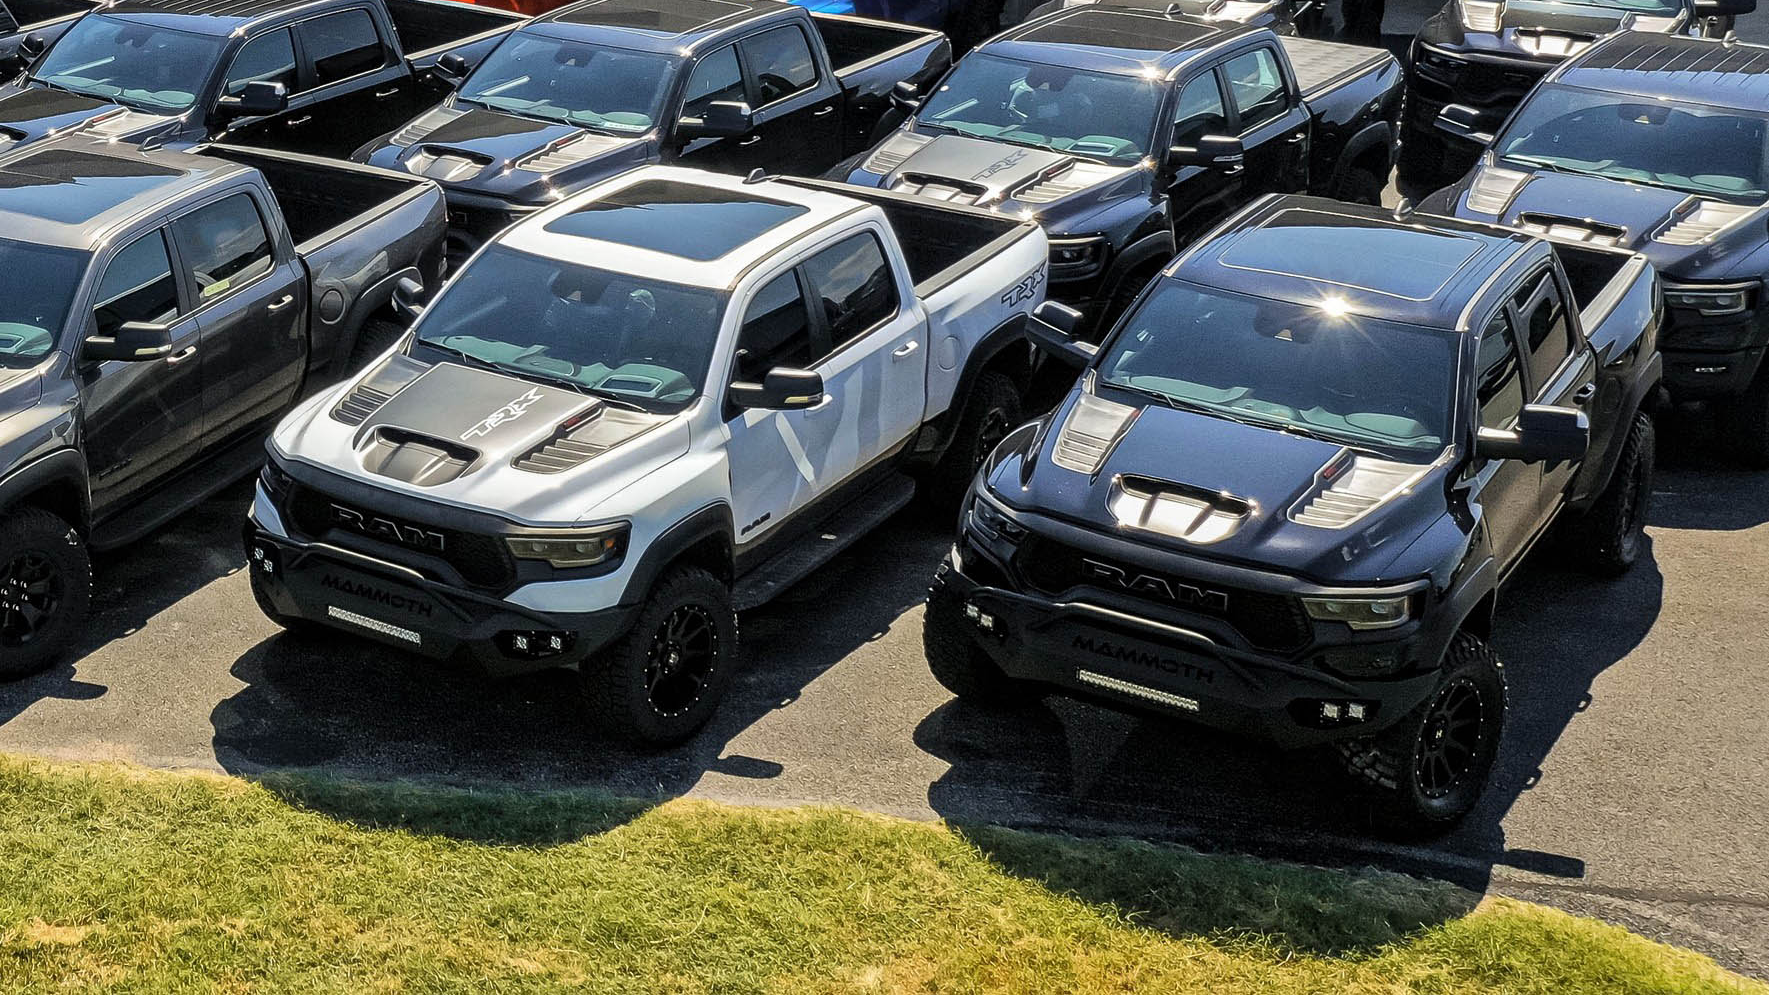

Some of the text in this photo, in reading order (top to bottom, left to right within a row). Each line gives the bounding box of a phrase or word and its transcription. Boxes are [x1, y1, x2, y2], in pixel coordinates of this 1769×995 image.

[970, 149, 1029, 181] TRX
[1001, 259, 1047, 308] TRX
[459, 386, 545, 441] TRX
[329, 503, 446, 552] RAM
[740, 511, 771, 536] RAM
[320, 573, 434, 617] MAMMOTH
[1081, 557, 1229, 613] RAM
[1072, 635, 1215, 684] MAMMOTH
